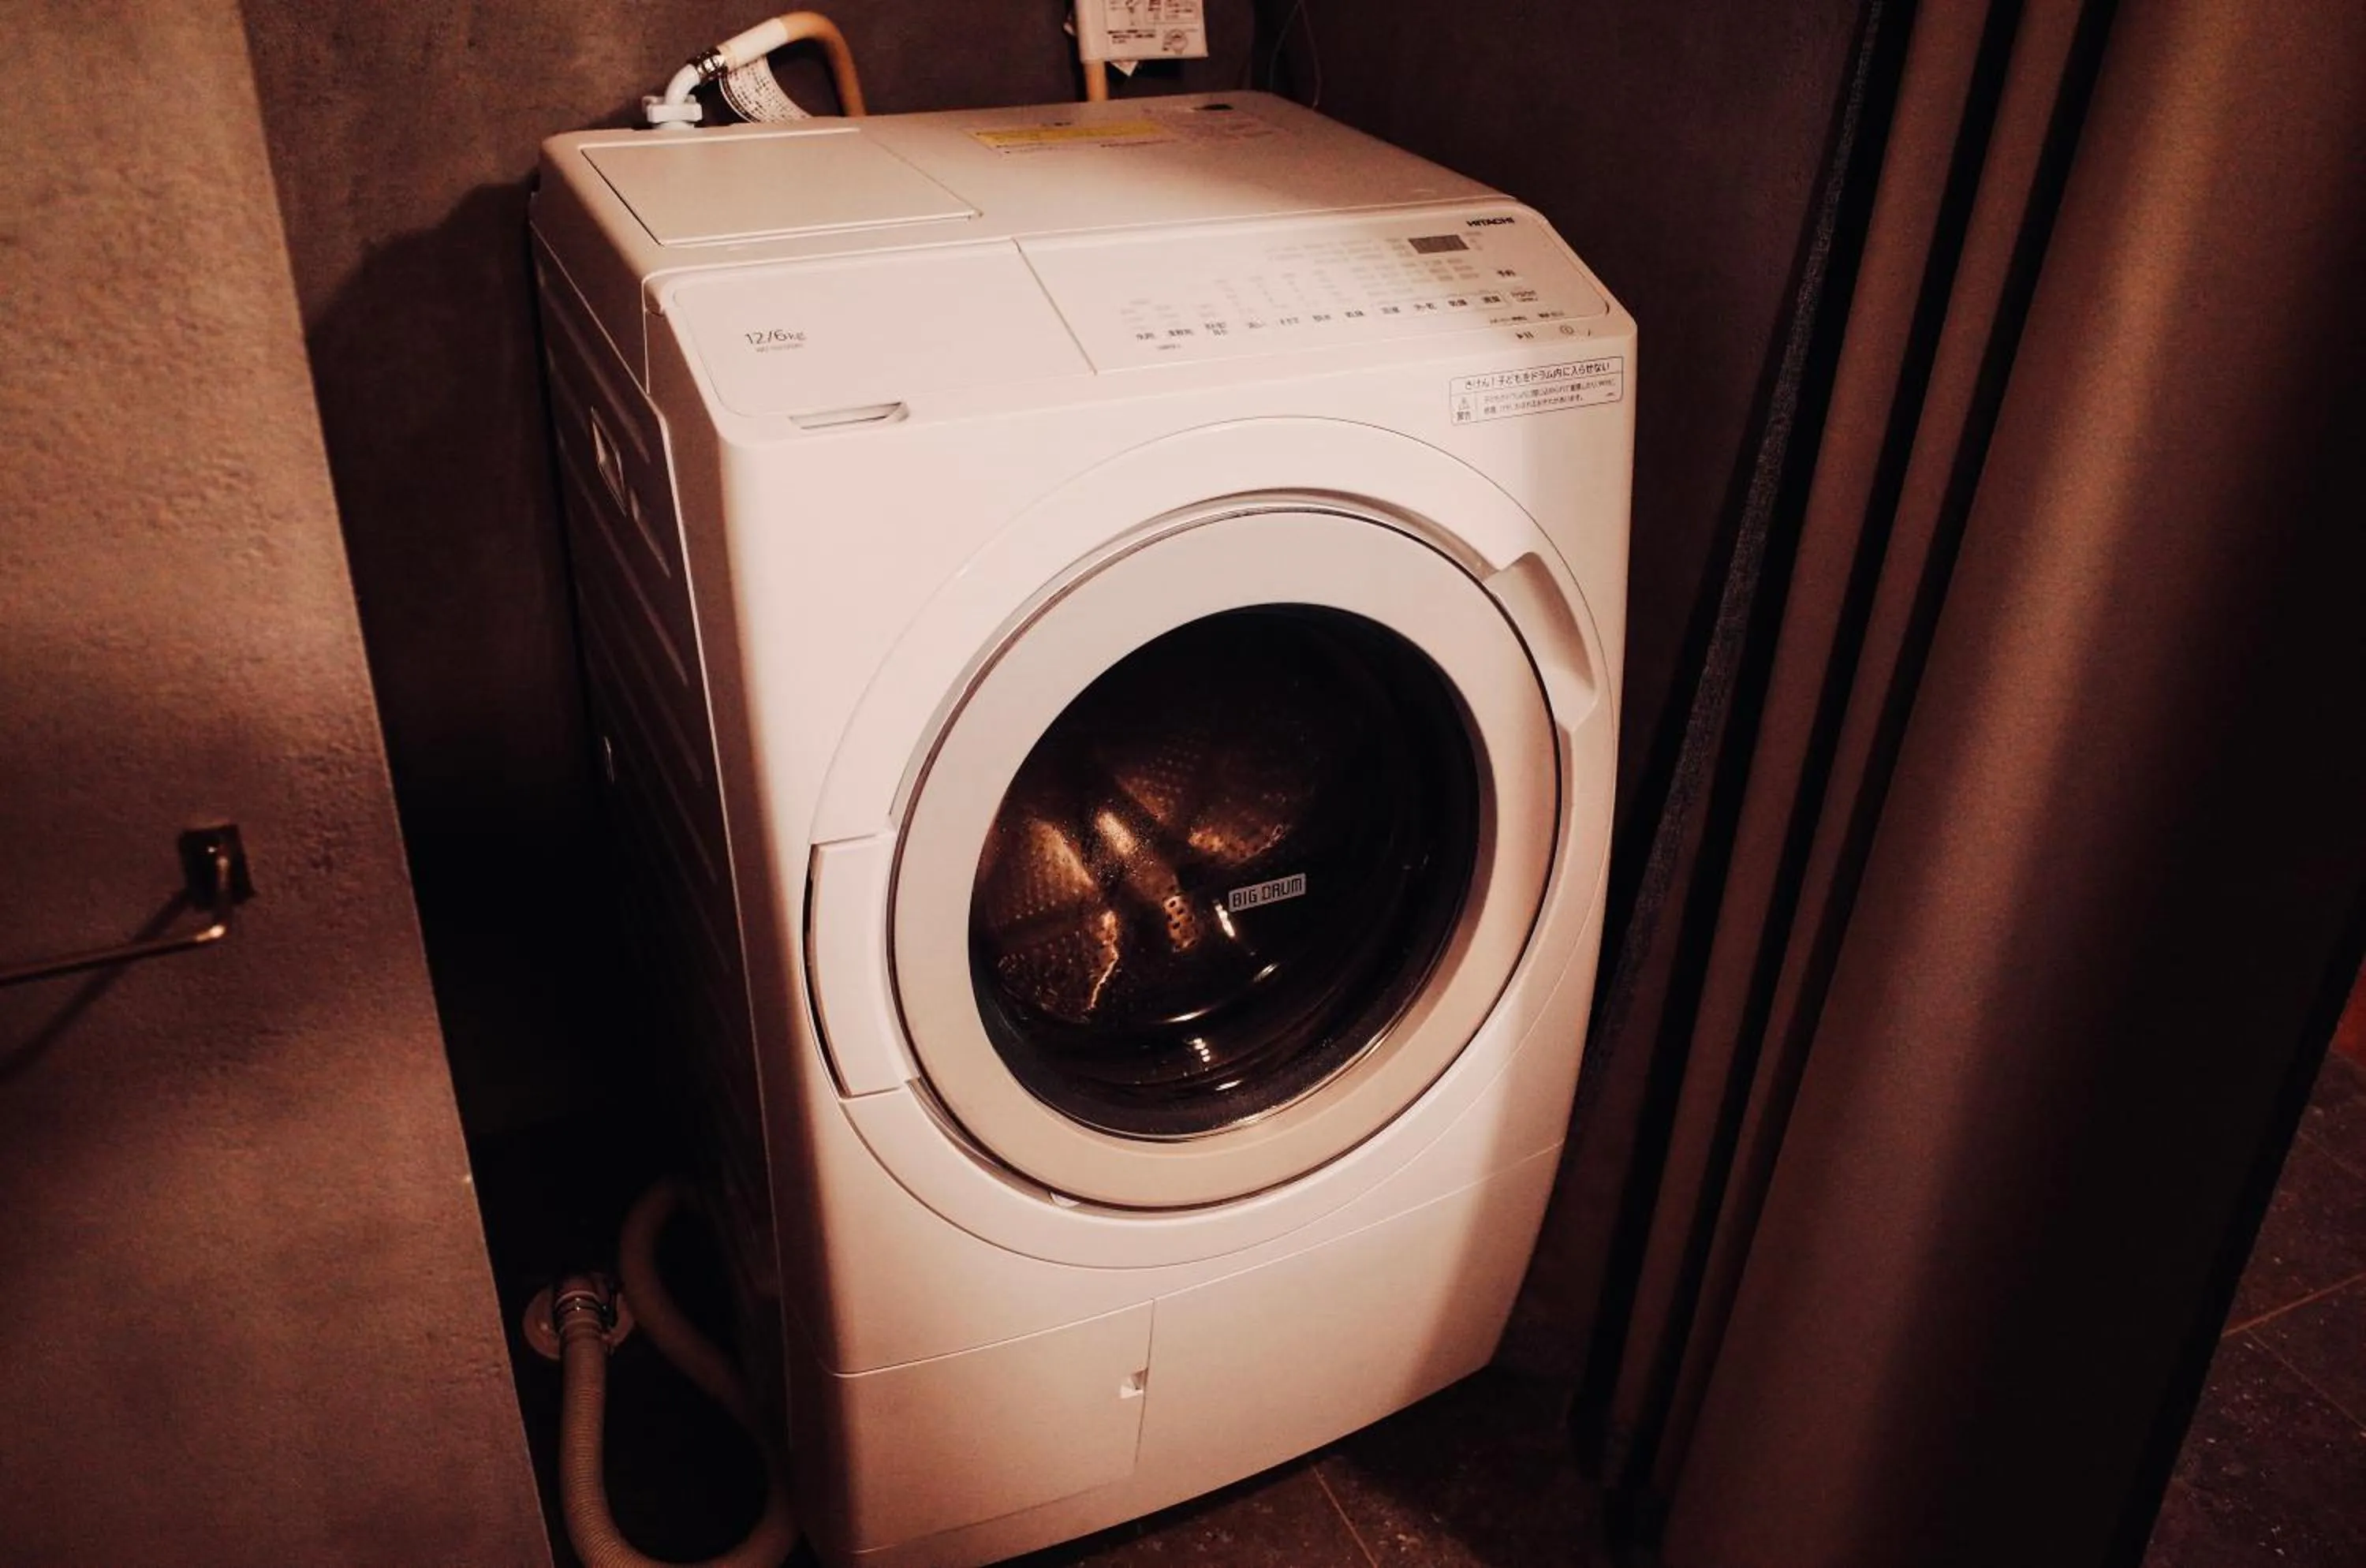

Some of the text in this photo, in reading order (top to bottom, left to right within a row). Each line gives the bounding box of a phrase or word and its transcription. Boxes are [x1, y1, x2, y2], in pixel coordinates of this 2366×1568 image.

[1466, 217, 1514, 227] HITACHI
[1233, 878, 1302, 908] BIG DRUM
